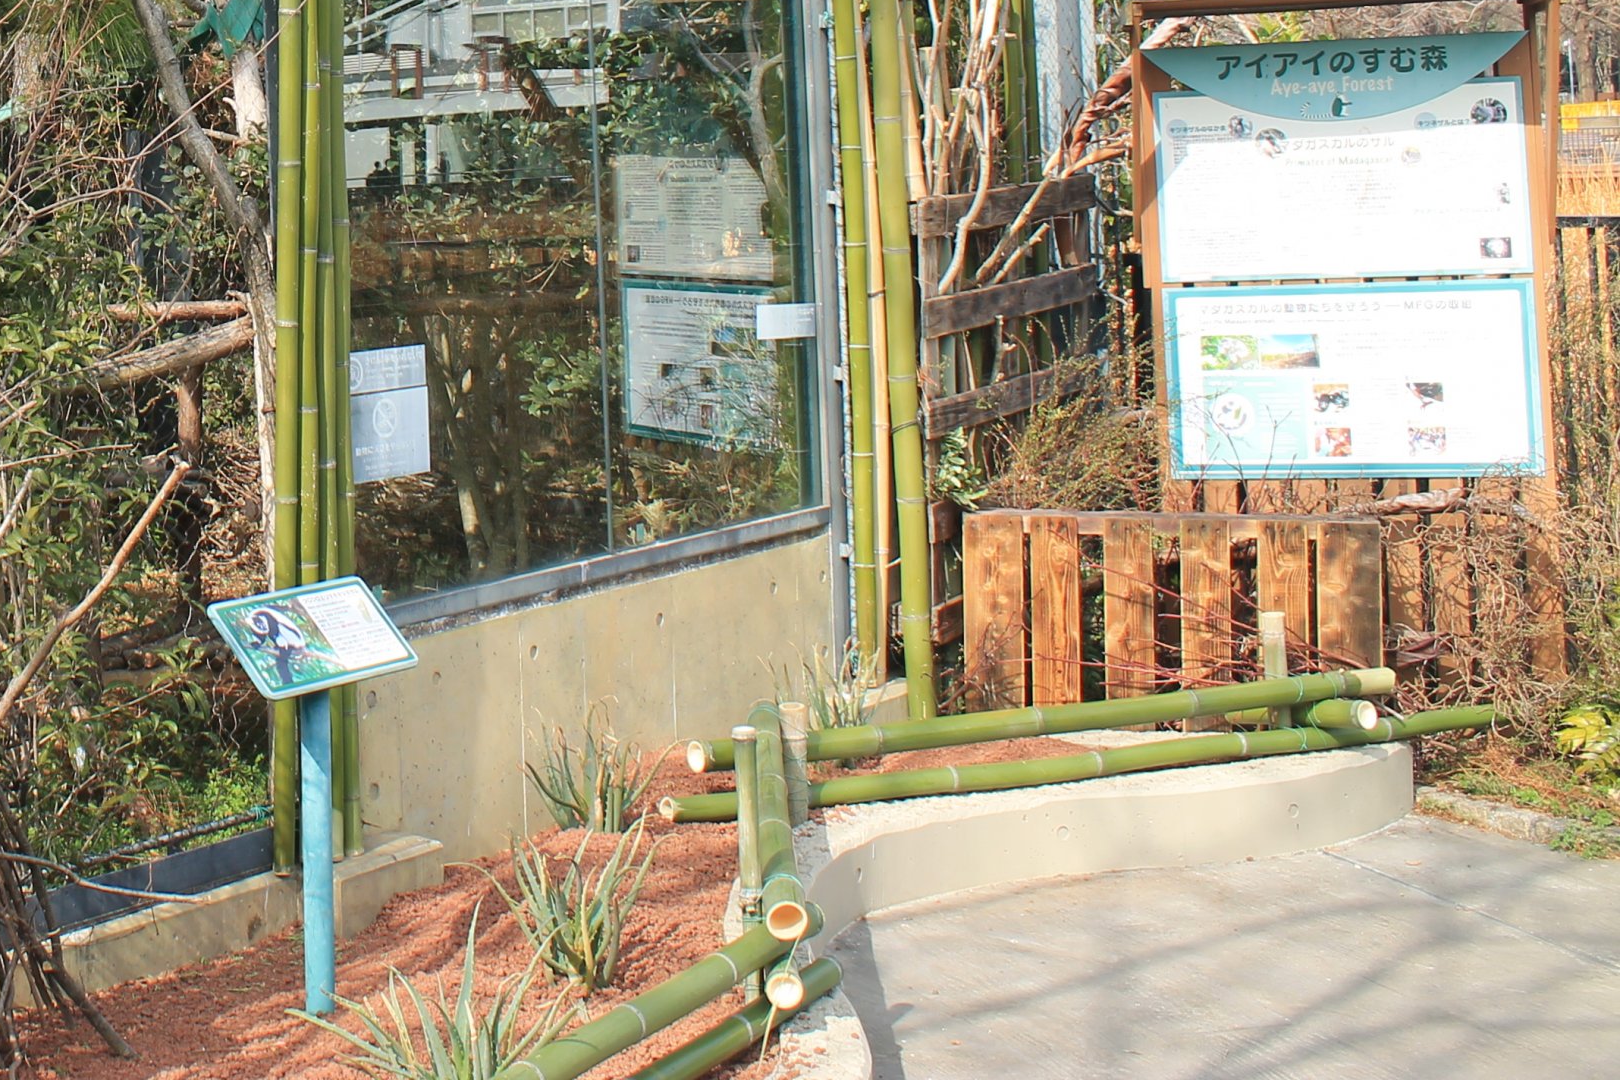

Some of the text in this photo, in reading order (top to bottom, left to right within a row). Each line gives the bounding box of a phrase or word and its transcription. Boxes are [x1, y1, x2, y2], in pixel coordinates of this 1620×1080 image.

[1215, 44, 1449, 81] アイアイのすむ森
[1270, 75, 1394, 98] Aye-aye Forest
